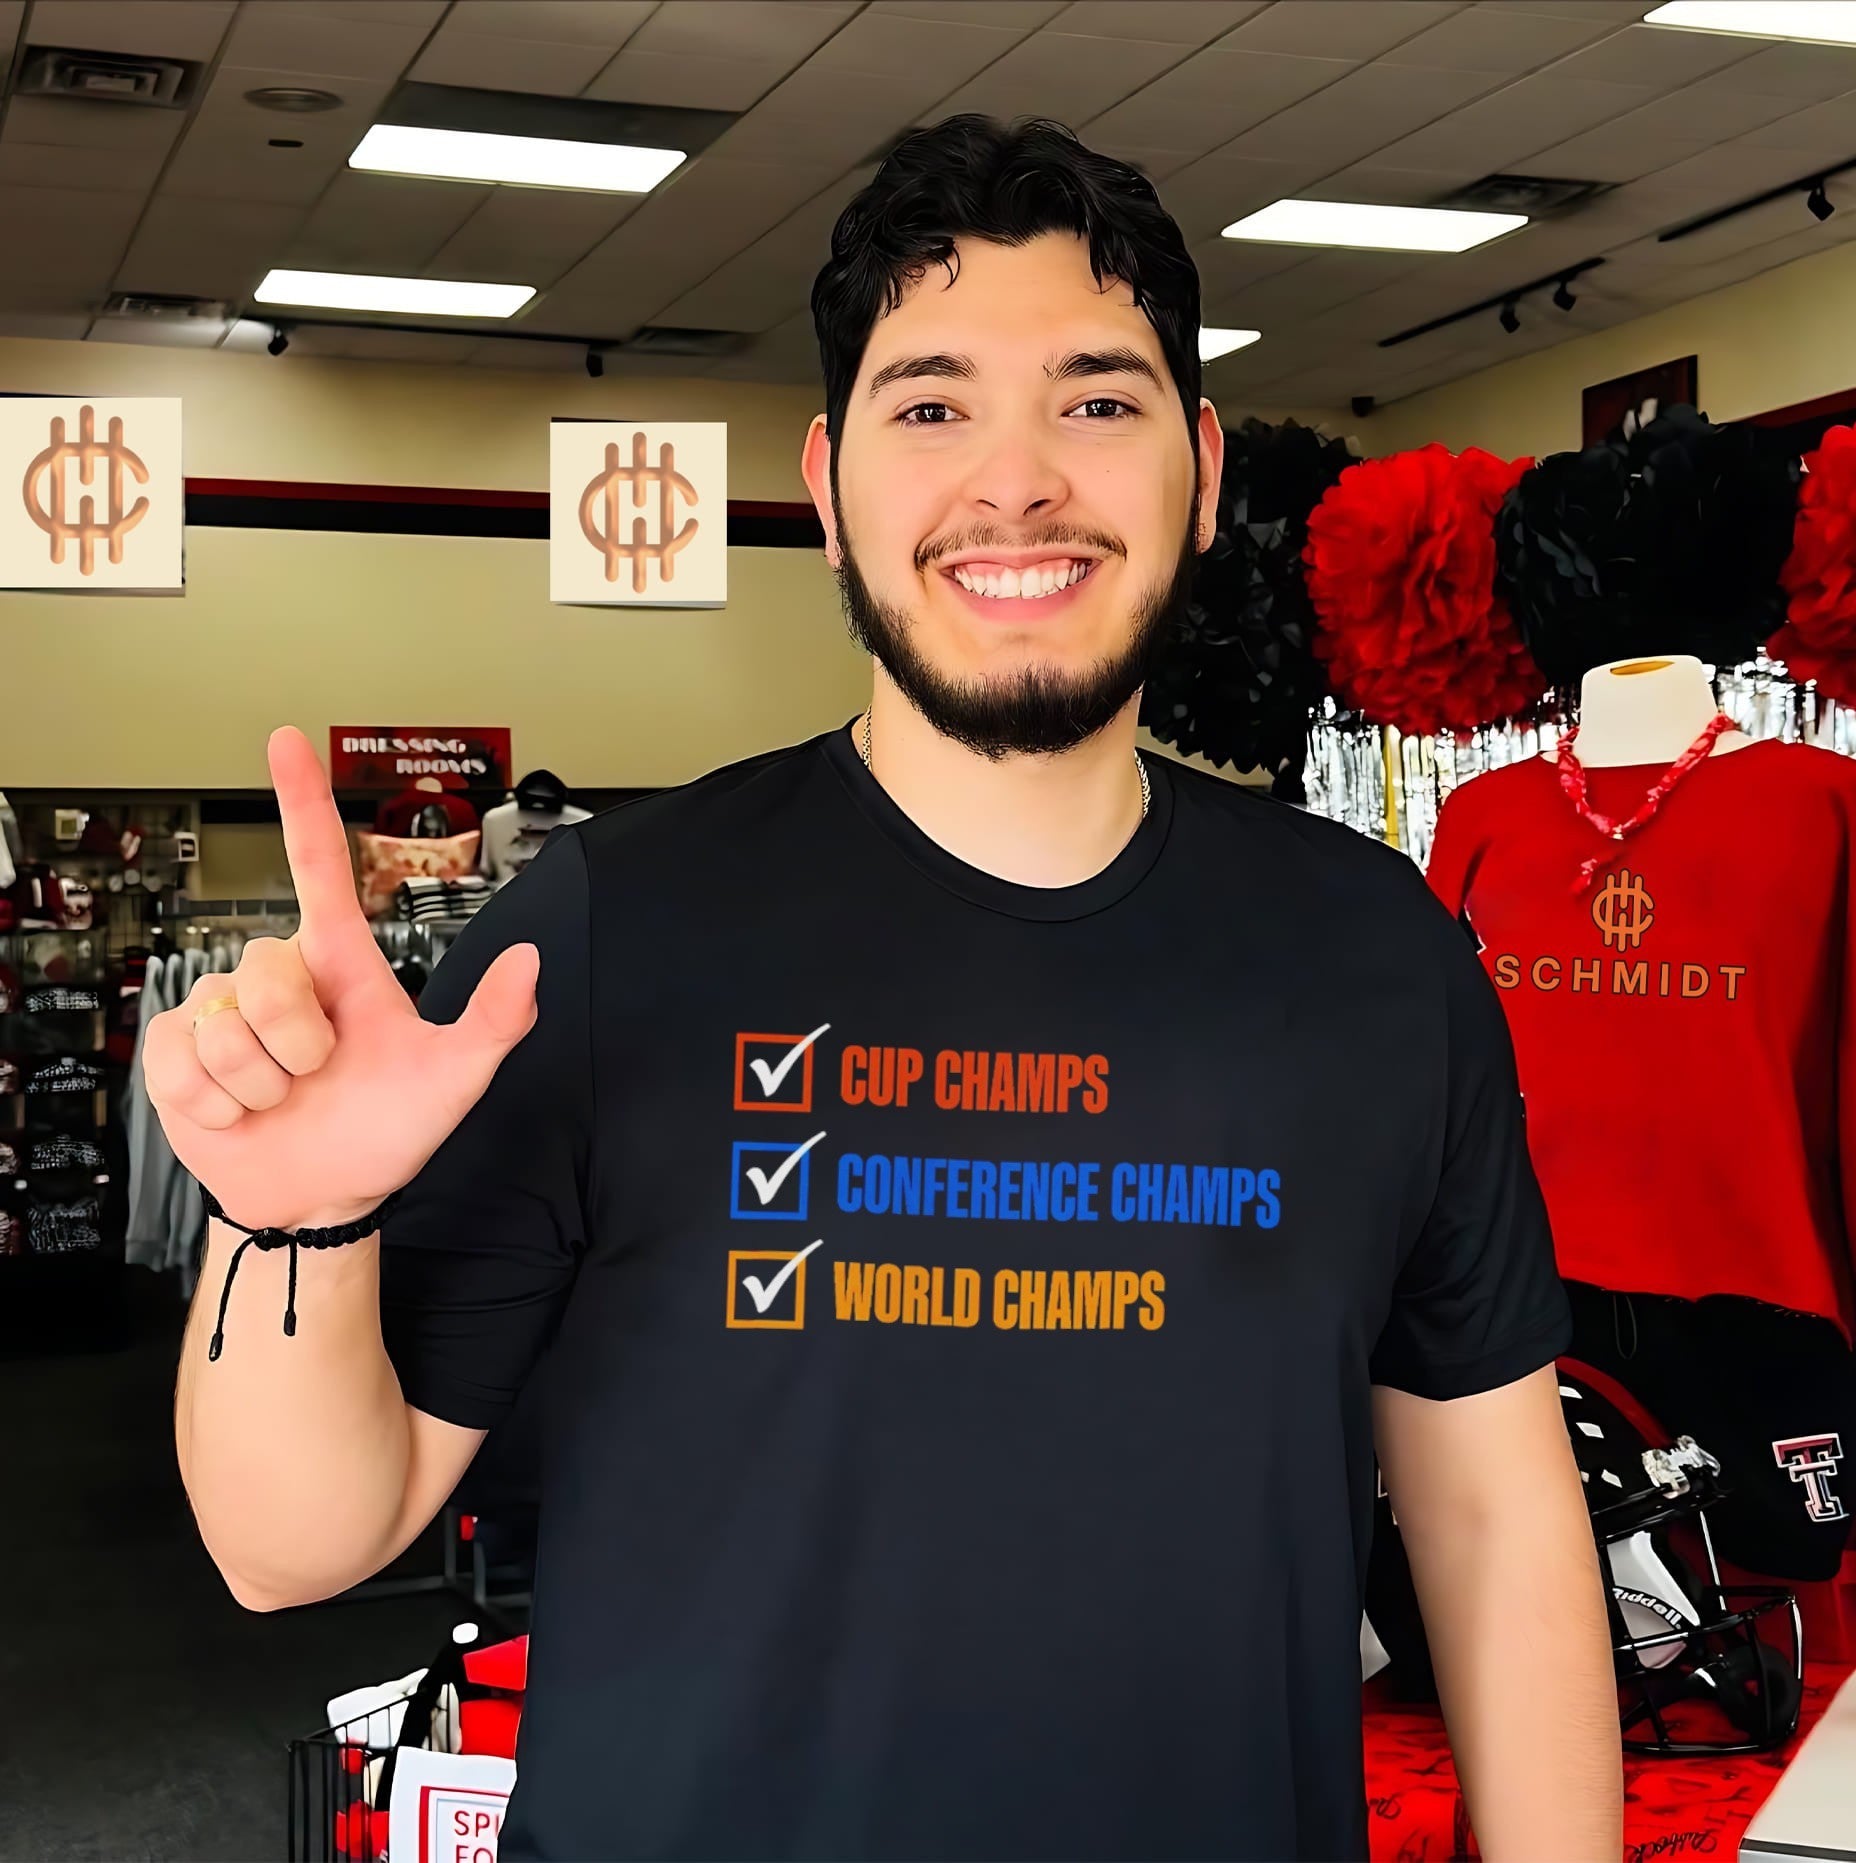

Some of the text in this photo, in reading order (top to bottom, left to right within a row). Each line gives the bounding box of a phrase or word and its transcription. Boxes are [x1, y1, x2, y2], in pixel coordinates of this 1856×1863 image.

[342, 737, 467, 754] DRESSING
[396, 758, 487, 775] ROOMS
[1493, 953, 1746, 1000] SCHMIDT
[840, 1045, 1109, 1114] CUP CHAMPS
[837, 1153, 1281, 1229] CONFERENCE CHAMPS
[833, 1261, 1165, 1330] WORLD CHAMPS
